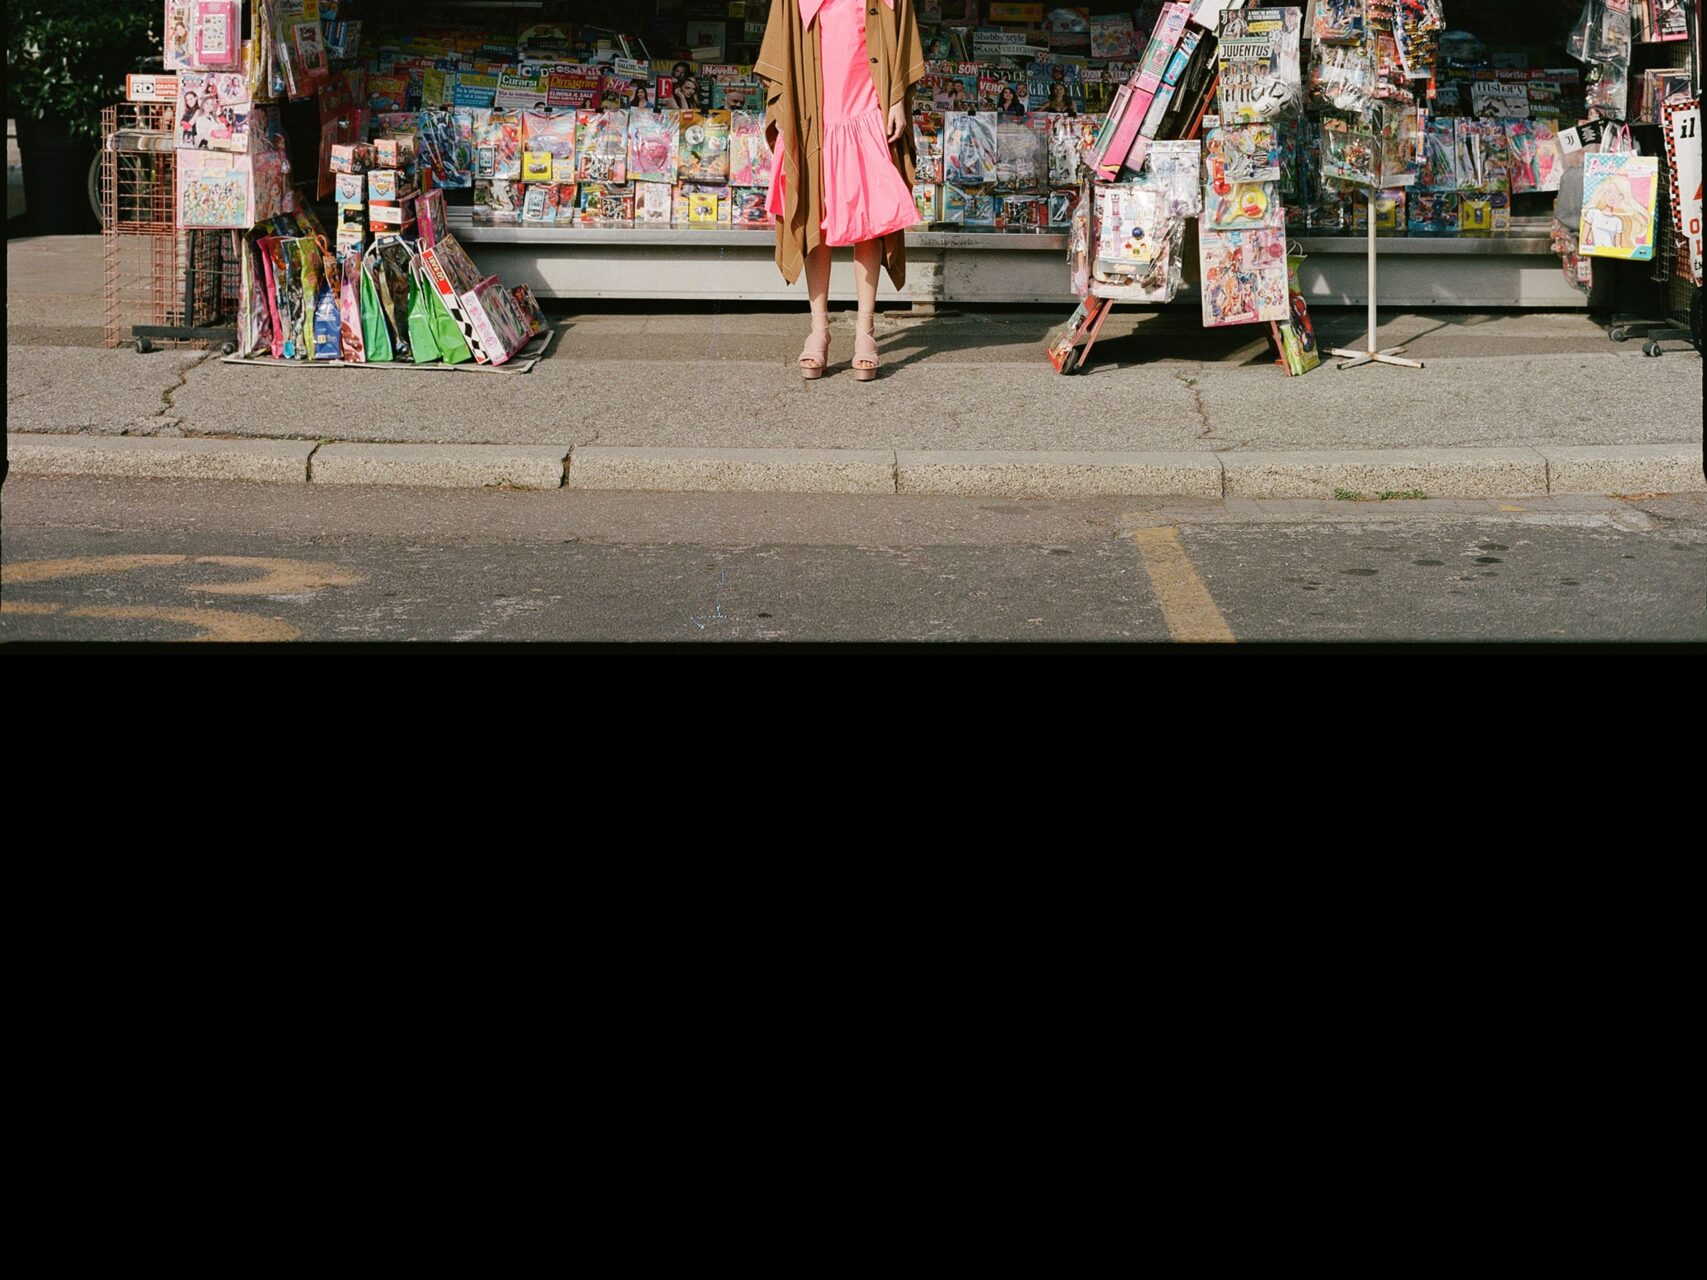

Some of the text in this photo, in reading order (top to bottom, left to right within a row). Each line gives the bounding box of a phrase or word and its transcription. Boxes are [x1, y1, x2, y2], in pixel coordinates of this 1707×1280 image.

[1222, 45, 1270, 57] JUVENTUS
[705, 66, 738, 75] Novella
[502, 74, 536, 87] Curarsi
[980, 80, 1004, 93] VERO
[661, 79, 672, 96] F
[1680, 117, 1696, 138] il
